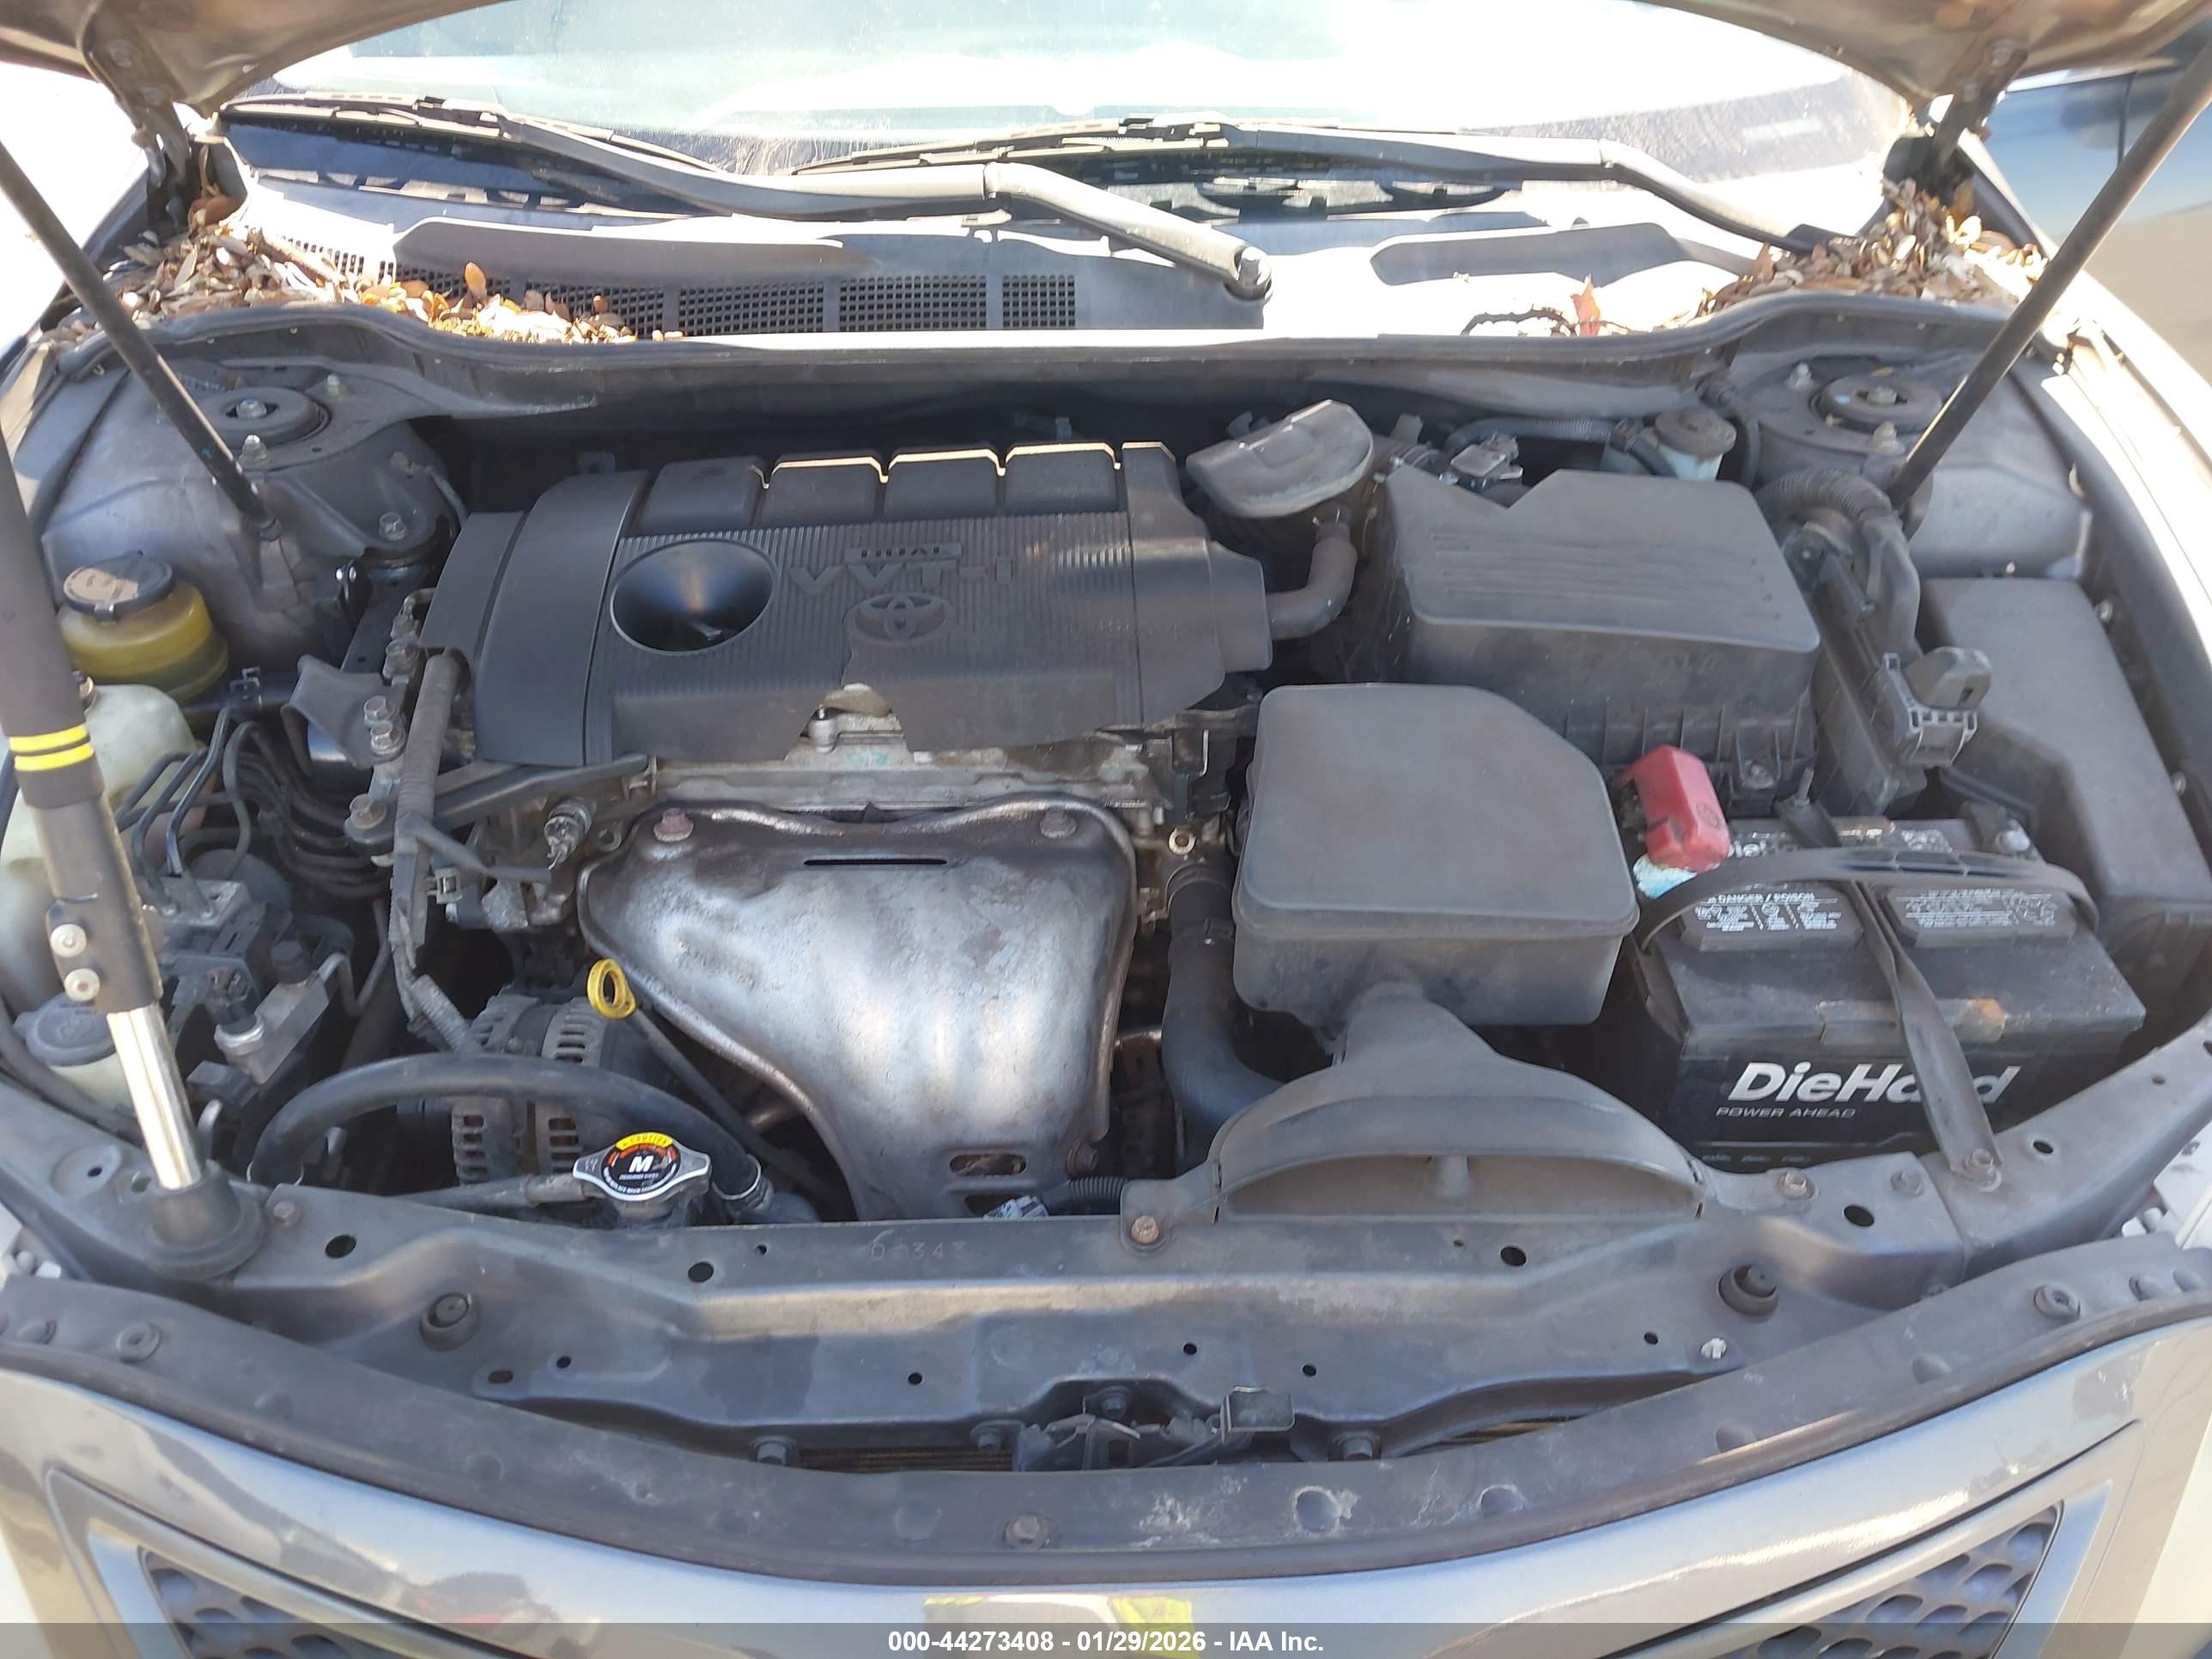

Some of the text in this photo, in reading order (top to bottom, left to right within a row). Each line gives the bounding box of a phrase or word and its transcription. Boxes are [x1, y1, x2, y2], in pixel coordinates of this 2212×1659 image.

[1727, 1061, 2021, 1103] DieHad
[1716, 1106, 1856, 1118] POWER AHEAD
[628, 1155, 655, 1173] M
